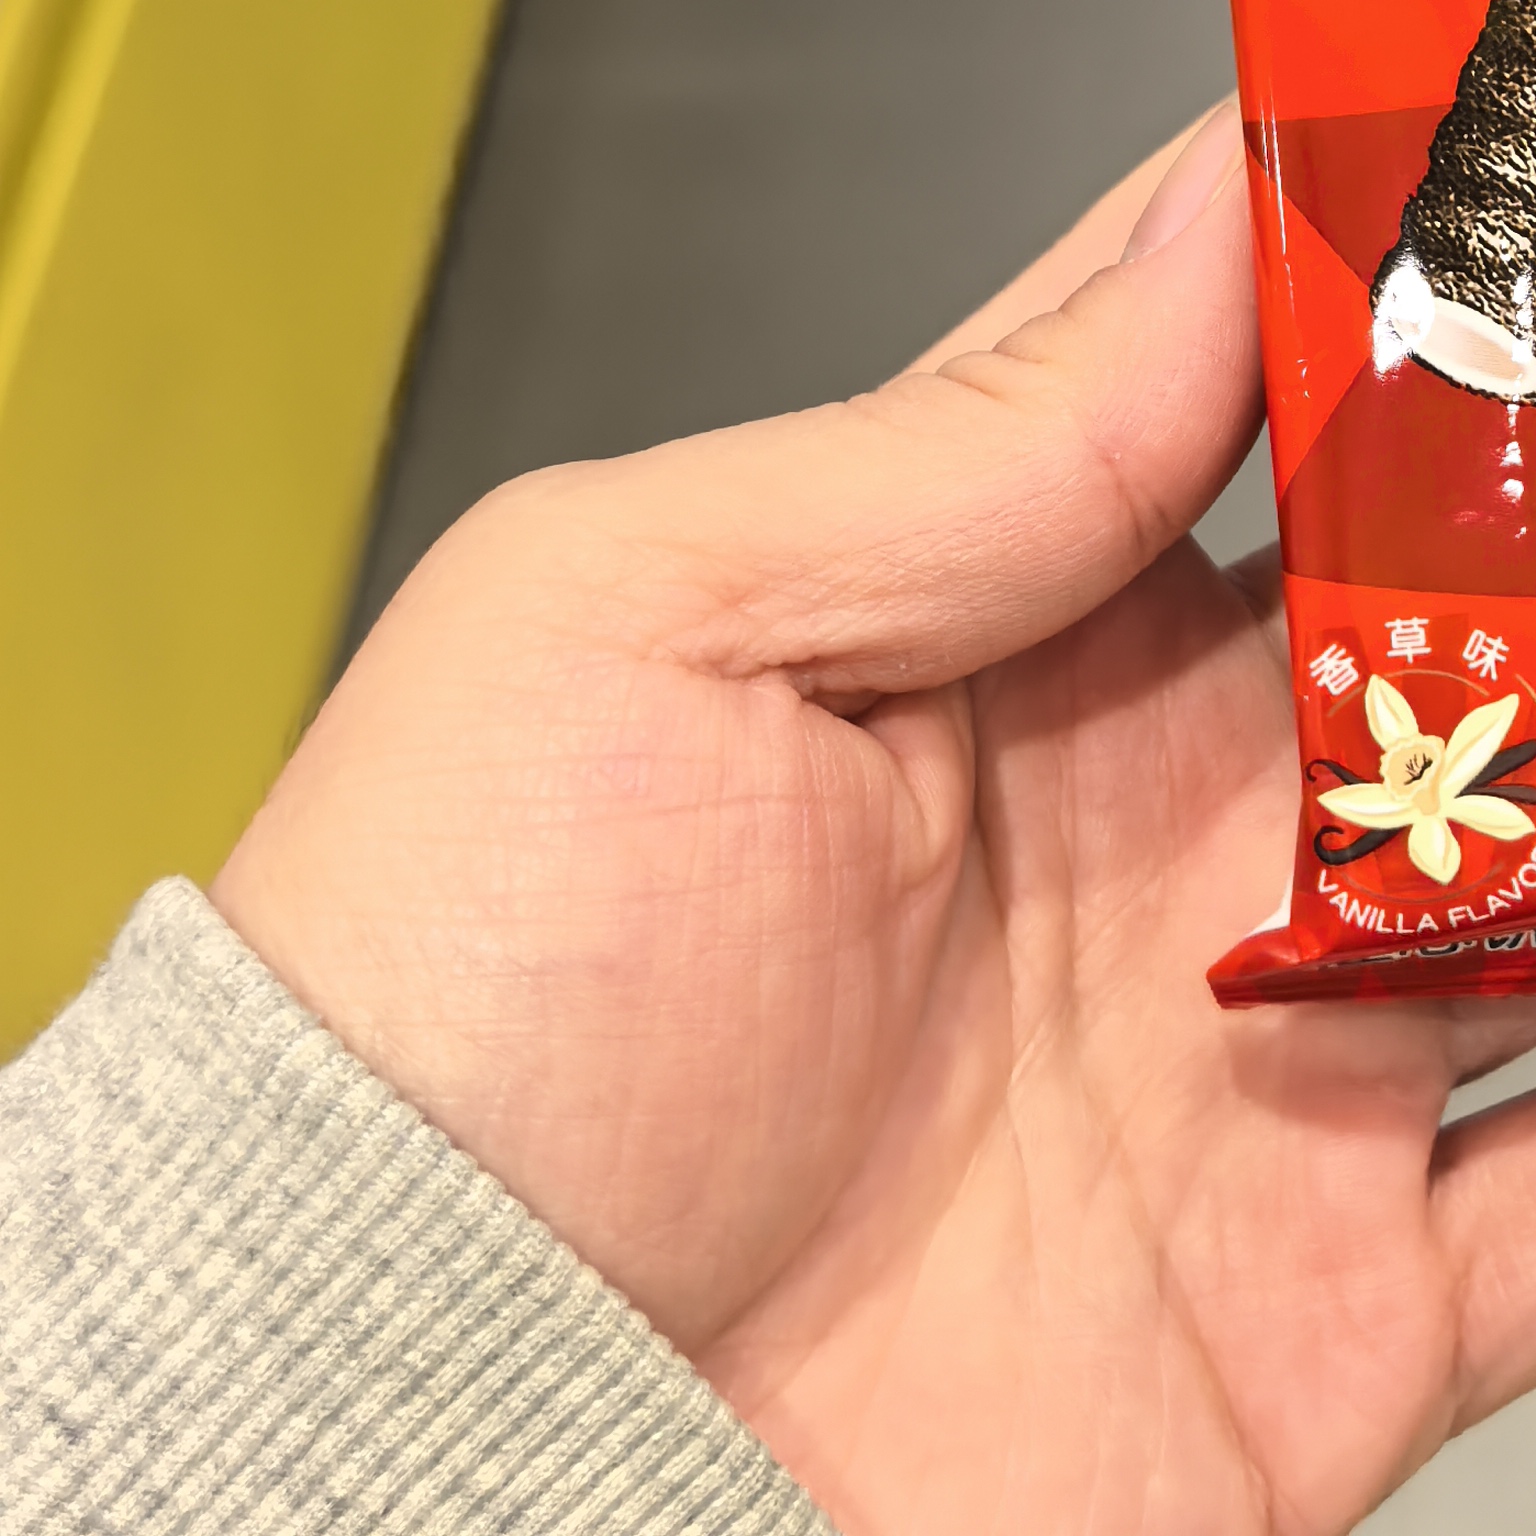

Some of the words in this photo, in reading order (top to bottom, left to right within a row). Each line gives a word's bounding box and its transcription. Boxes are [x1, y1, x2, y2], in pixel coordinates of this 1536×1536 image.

[1309, 617, 1510, 696] 香草味
[1317, 869, 1439, 934] VANILLA
